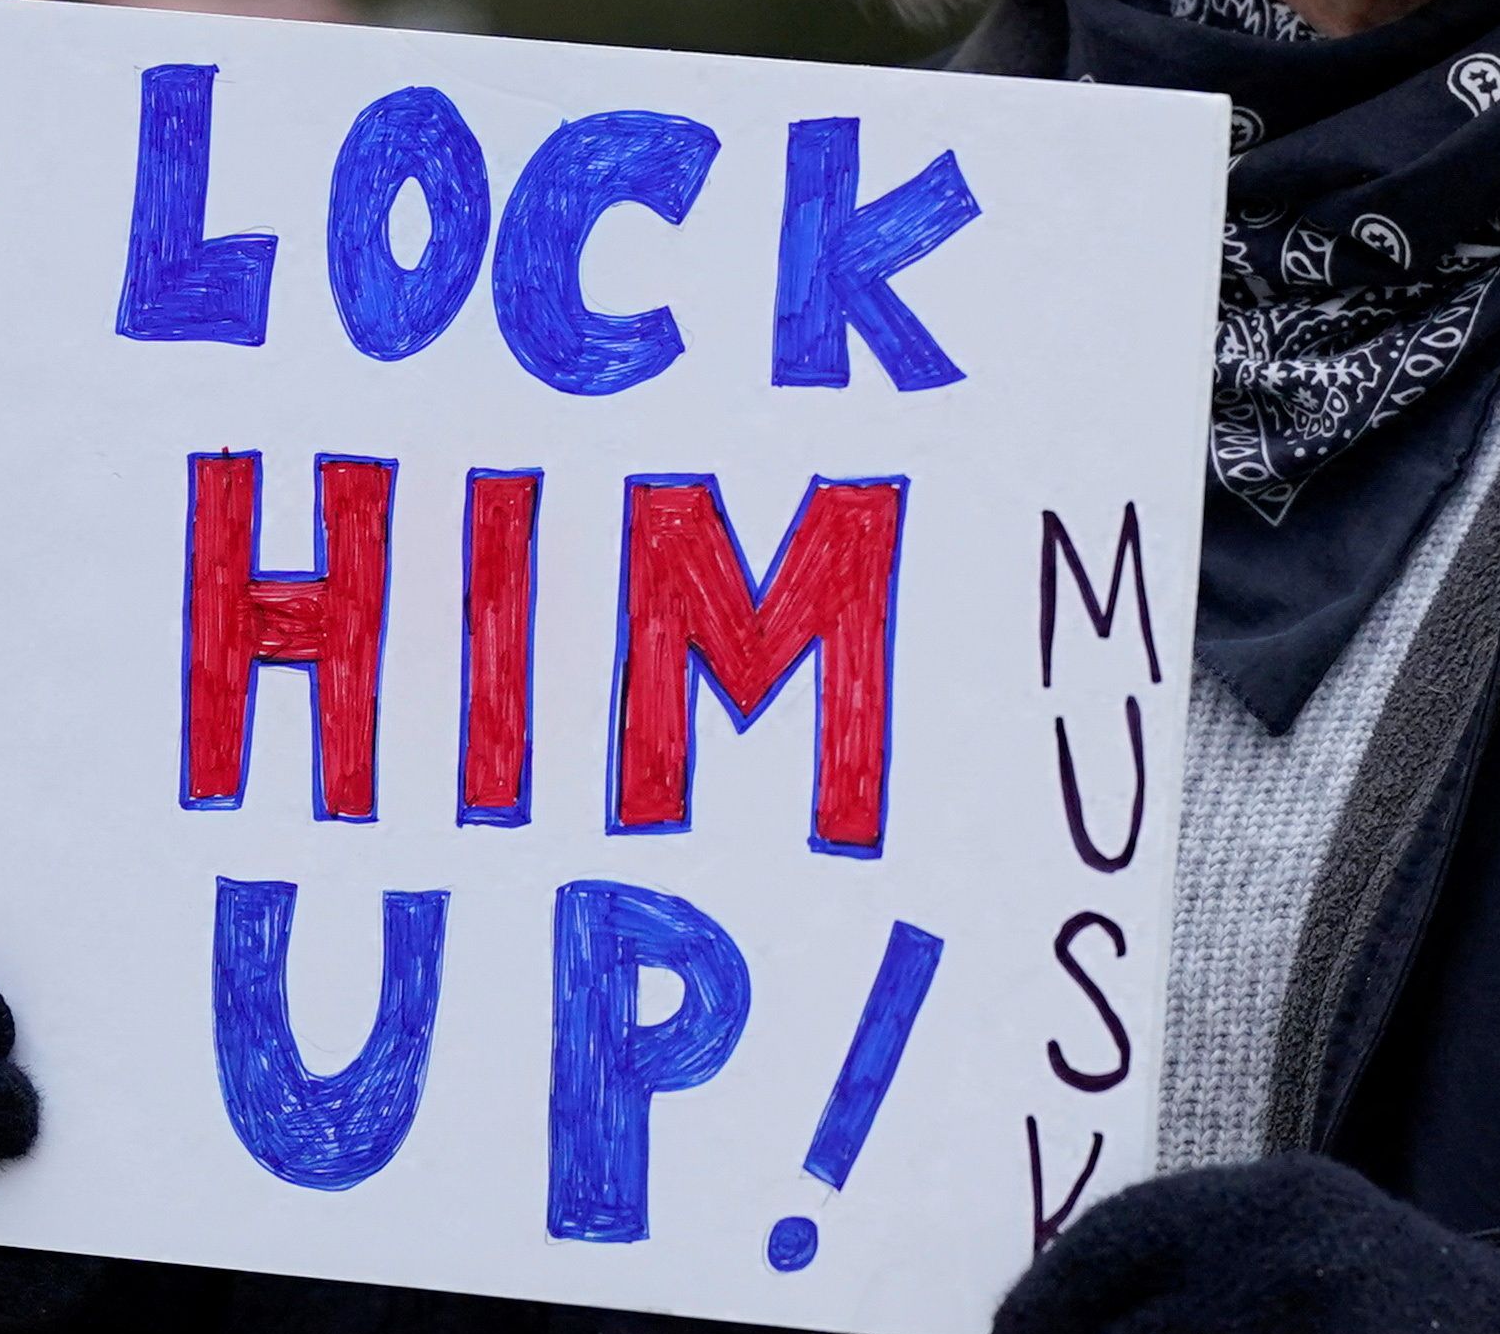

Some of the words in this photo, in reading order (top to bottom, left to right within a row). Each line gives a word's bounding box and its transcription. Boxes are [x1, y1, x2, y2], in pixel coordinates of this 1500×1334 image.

[115, 62, 984, 397] LOCK
[179, 446, 911, 860] HIM
[213, 874, 945, 1272] UP!
